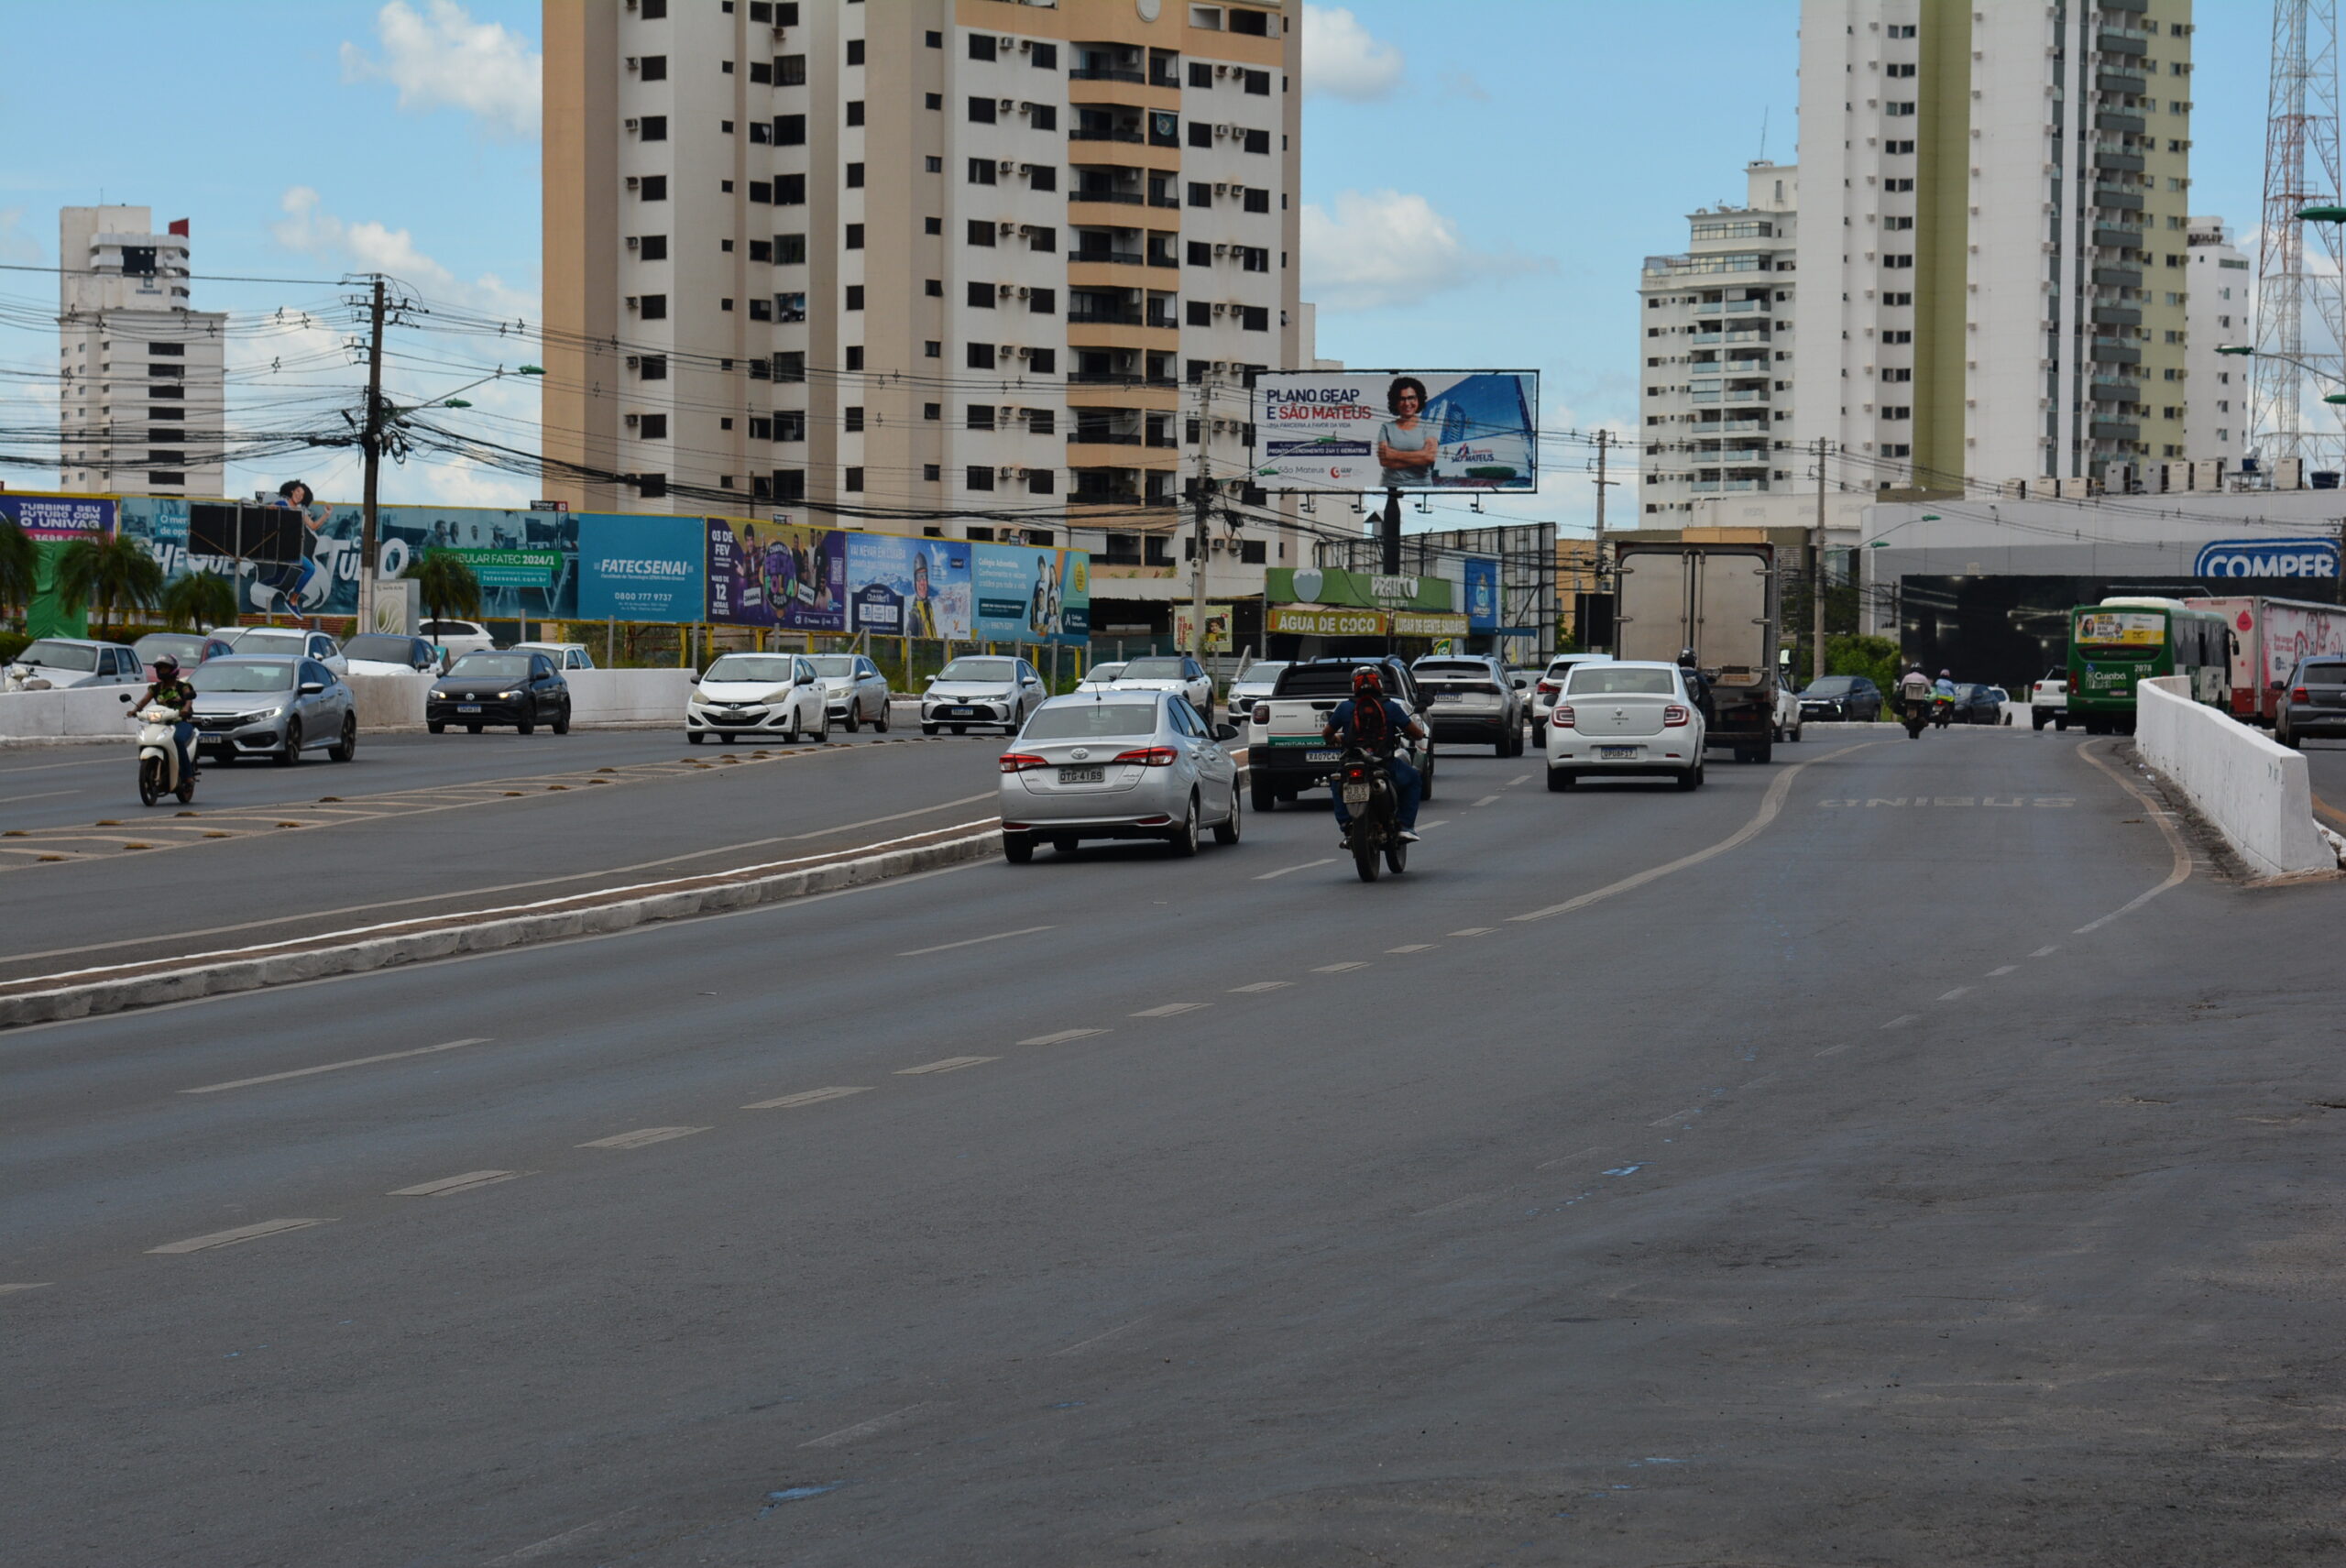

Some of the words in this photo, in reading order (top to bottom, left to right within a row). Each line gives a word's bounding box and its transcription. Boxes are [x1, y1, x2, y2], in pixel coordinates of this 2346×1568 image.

[1266, 389, 1317, 403] PLANO
[1321, 389, 1360, 403] GEAP
[1266, 406, 1277, 420] E
[1278, 402, 1310, 420] SÃO
[1312, 405, 1372, 420] MATEUS
[1295, 466, 1325, 474] Mateus
[20, 502, 72, 512] TURBINE
[76, 505, 101, 513] SEU
[20, 510, 69, 519] FUTURO
[72, 512, 101, 521] COM
[20, 517, 33, 527] O
[38, 518, 100, 529] UNIVAG
[711, 530, 721, 543] 03
[722, 530, 734, 543] DE
[715, 543, 731, 556] FEV
[491, 554, 521, 565] FATEC
[522, 554, 555, 565] 2024/1
[2206, 554, 2335, 577] COMPER
[601, 558, 688, 576] FATECSENAI
[614, 591, 636, 601] 0800
[638, 592, 652, 601] 777
[653, 593, 673, 602] 9737
[715, 584, 728, 600] 12
[1278, 613, 1315, 631] ÁGUA
[1319, 616, 1336, 632] DE
[1339, 617, 1376, 632] COCO
[1396, 618, 1415, 633] LUGAR
[1415, 618, 1423, 633] DE
[1423, 618, 1442, 634] GENTE
[1442, 617, 1467, 635] SAUDÁVEL
[2134, 664, 2153, 673] 2078
[2094, 672, 2126, 680] Cuiabá
